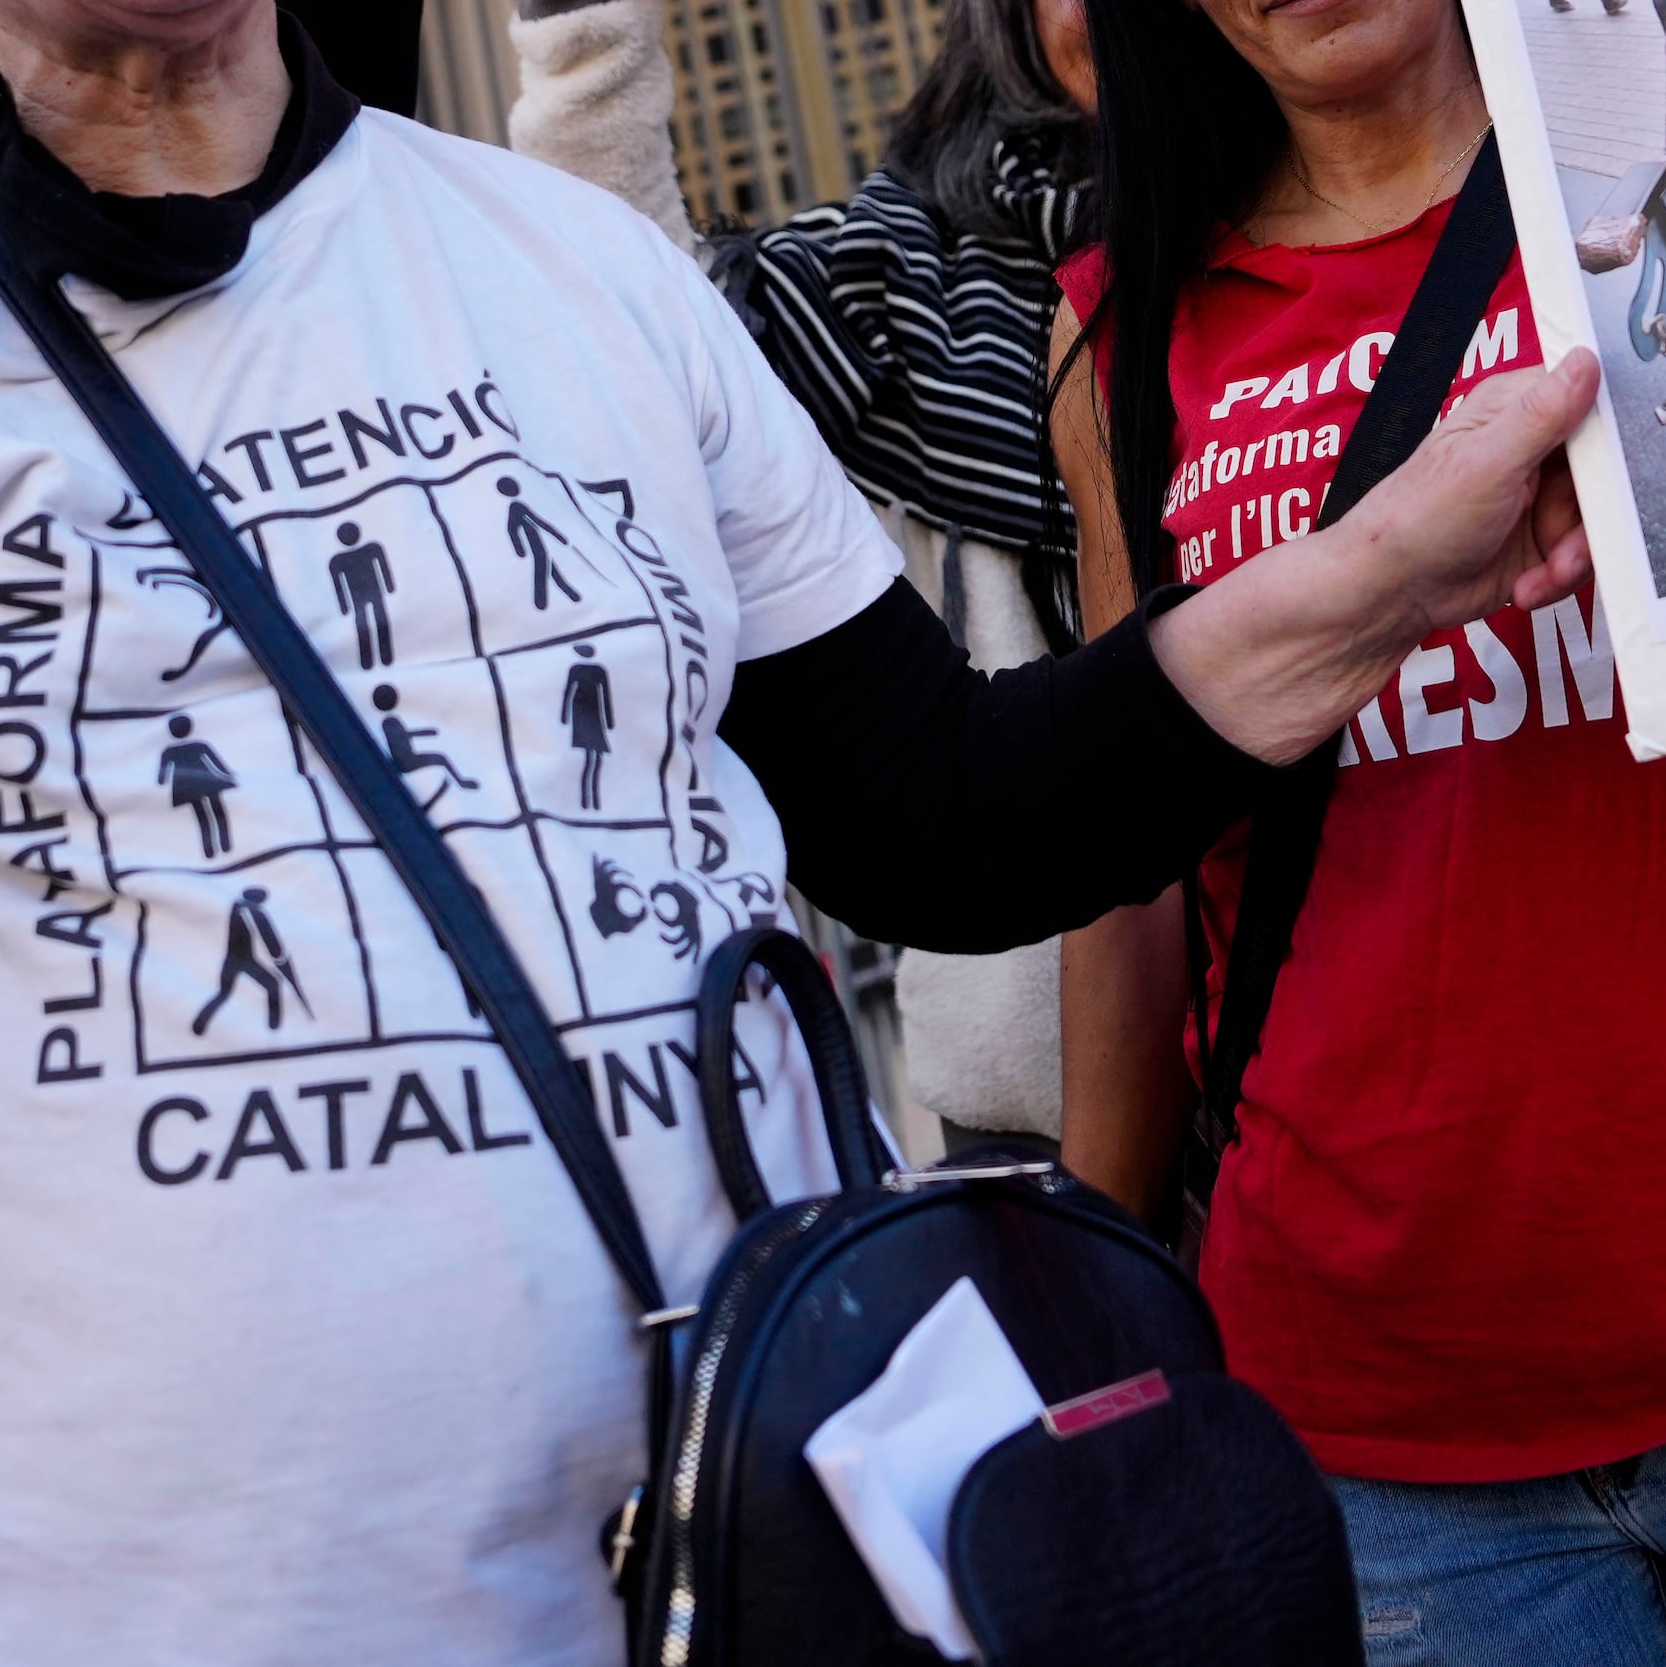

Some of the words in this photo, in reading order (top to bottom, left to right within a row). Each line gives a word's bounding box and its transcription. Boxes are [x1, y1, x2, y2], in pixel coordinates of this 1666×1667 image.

[1208, 307, 1519, 421] PAICM
[1180, 527, 1217, 584] per
[1230, 481, 1332, 560] l'IC
[137, 1038, 767, 1187] CATALNA
